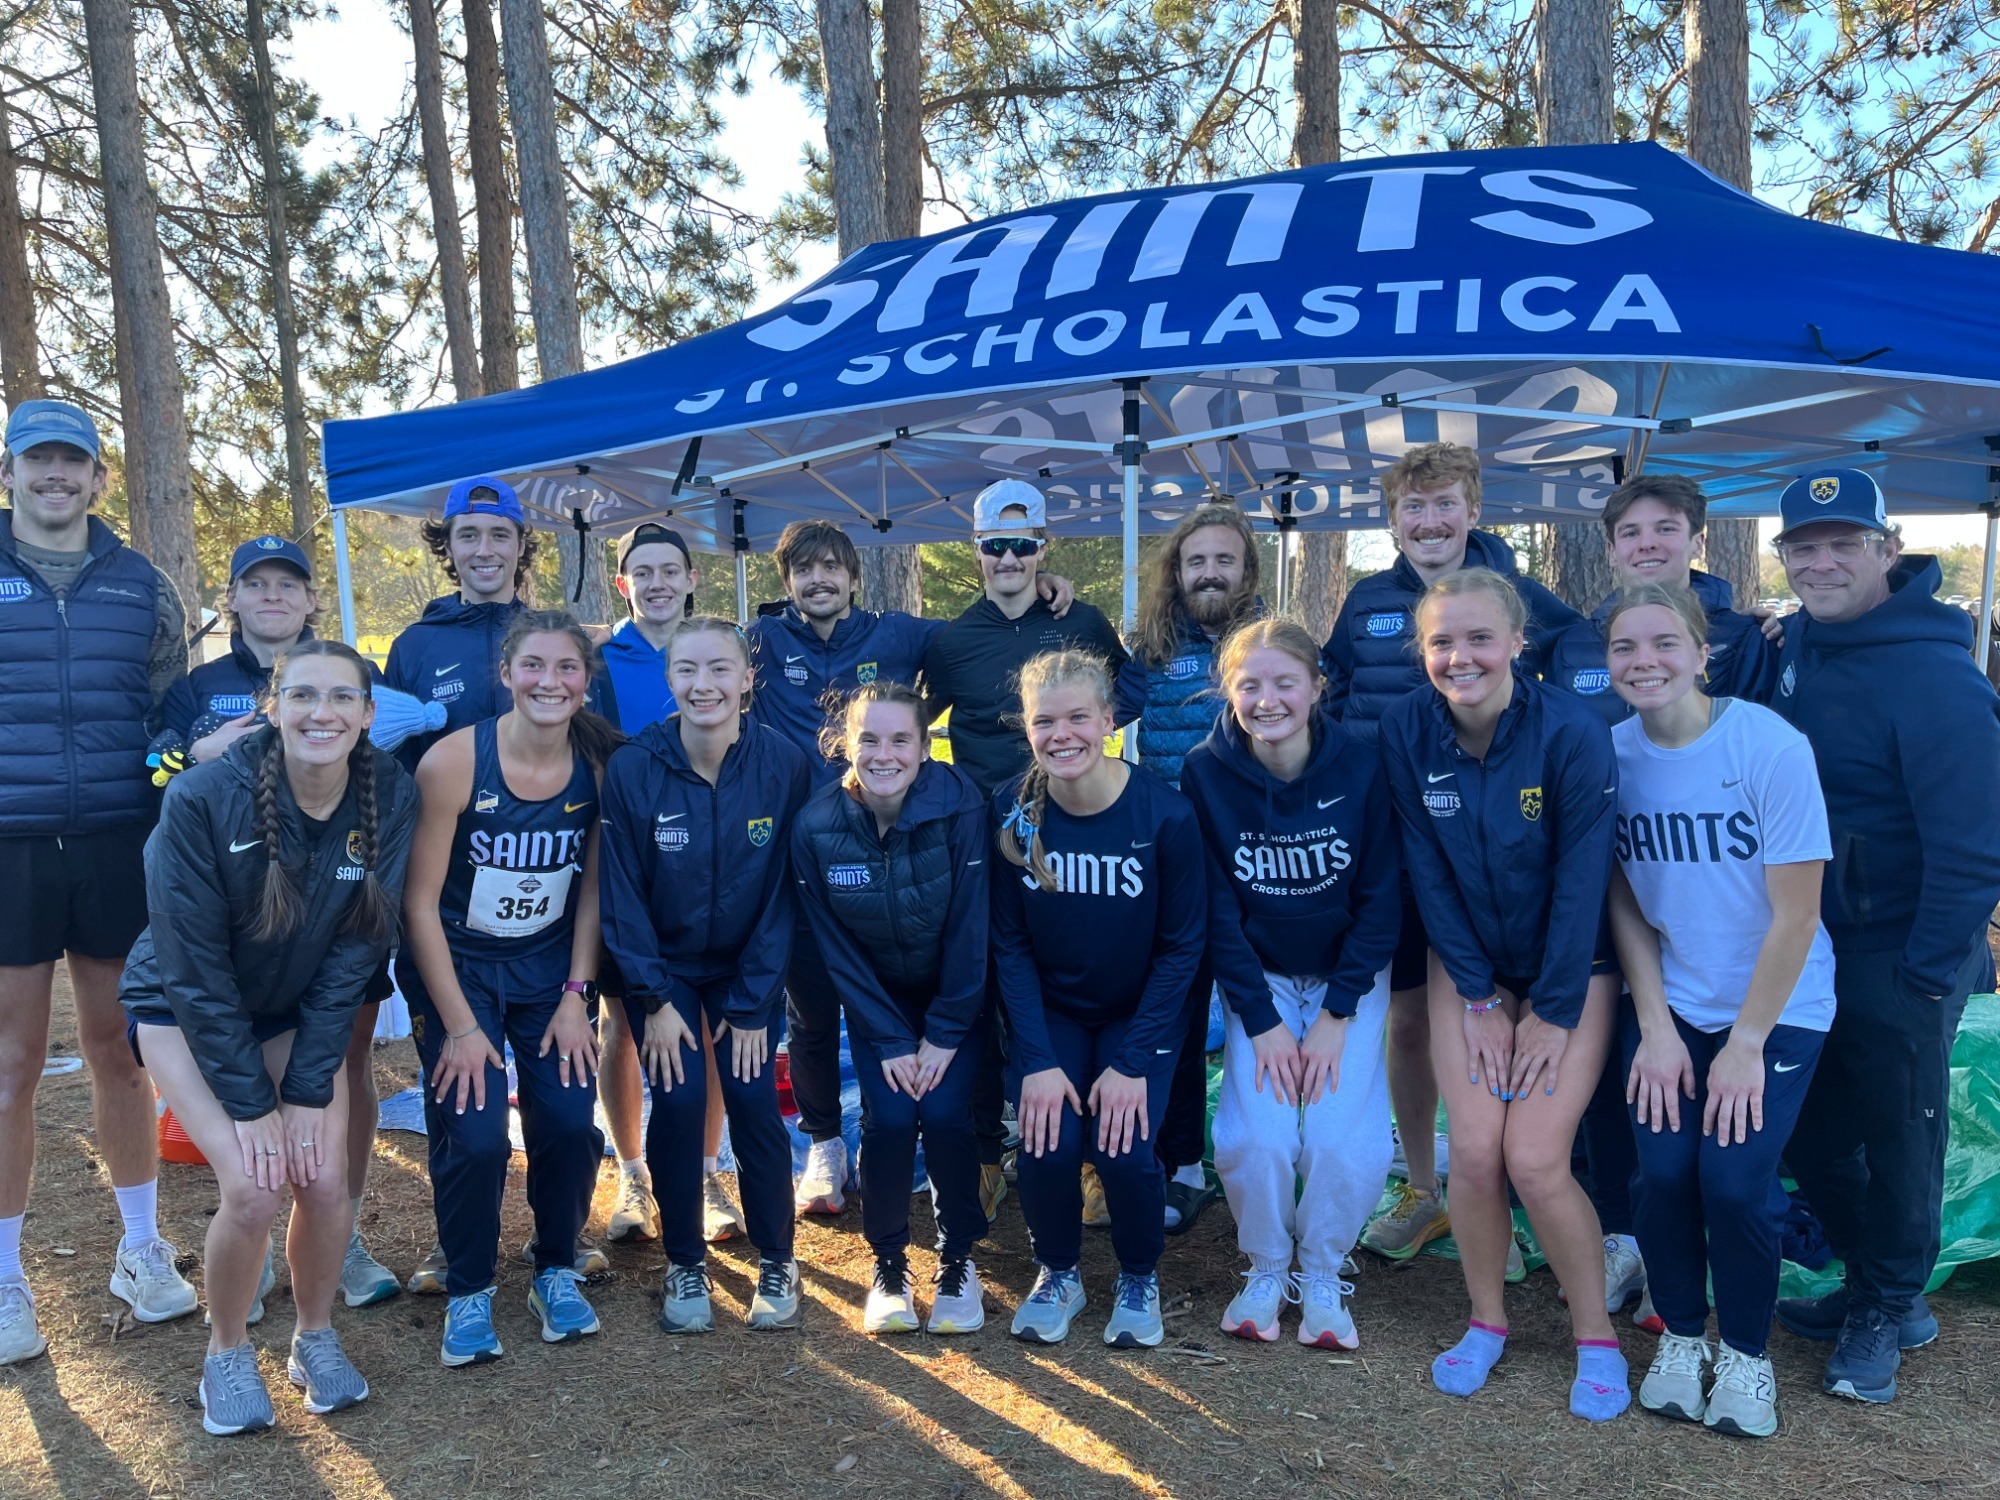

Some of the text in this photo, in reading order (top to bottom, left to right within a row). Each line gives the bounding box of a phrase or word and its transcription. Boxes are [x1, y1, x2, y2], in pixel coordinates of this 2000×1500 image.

[746, 166, 1654, 352] SAINTS
[836, 274, 1682, 386] SCHOLASTICA
[1367, 617, 1405, 632] SAINTS
[1573, 673, 1611, 689] SAINTS
[432, 681, 466, 699] SAINTS
[210, 697, 257, 711] SAINTS
[1423, 795, 1461, 809] SAINTS
[654, 831, 689, 845] SAINTS
[1239, 831, 1257, 842] ST.
[1614, 810, 1760, 863] SAINTS
[468, 827, 587, 868] SAINTS
[1233, 838, 1353, 882] SAINTS
[335, 866, 365, 881] SAIN
[827, 869, 871, 886] SAINTS
[1251, 873, 1340, 897] CROSS COUNTRY
[495, 896, 551, 921] 354
